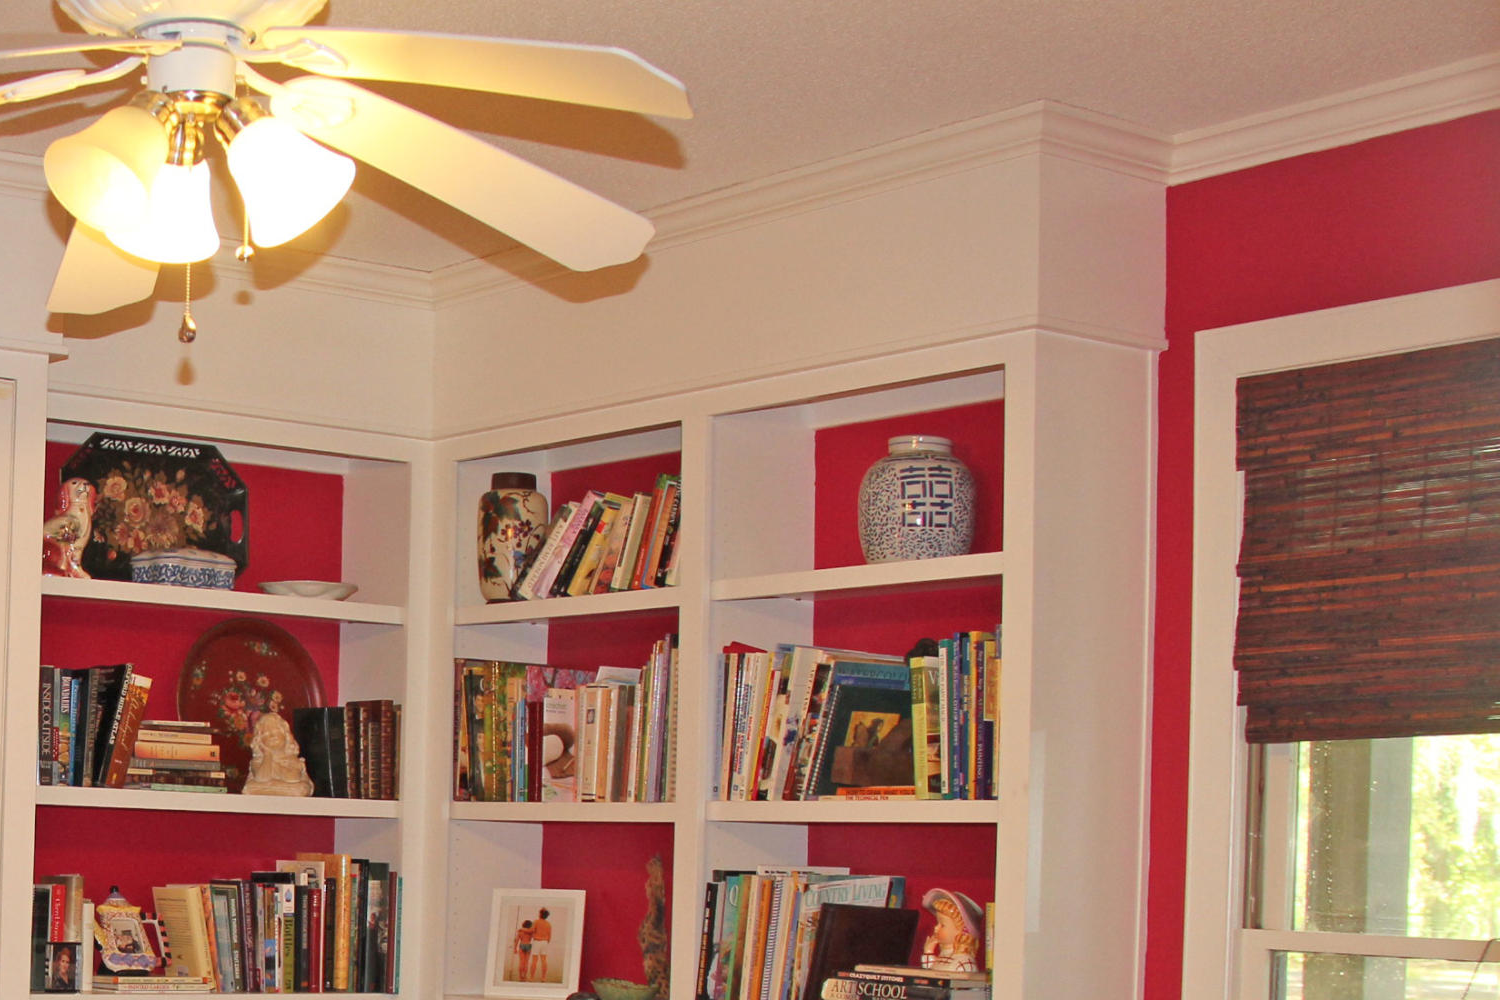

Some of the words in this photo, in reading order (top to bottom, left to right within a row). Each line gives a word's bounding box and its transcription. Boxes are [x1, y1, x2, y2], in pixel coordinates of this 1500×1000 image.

[61, 676, 72, 714] BOUNDARIES
[121, 664, 133, 696] OXFORD
[42, 683, 52, 713] INSIDE
[116, 696, 125, 720] BIBLE
[42, 714, 51, 755] OUTSIDE
[108, 720, 119, 745] ATLAS
[805, 886, 852, 907] COUNTRY
[852, 882, 889, 900] LIVING
[284, 919, 293, 958] Bottles
[831, 980, 857, 993] ART
[857, 982, 908, 999] SCHOOL
